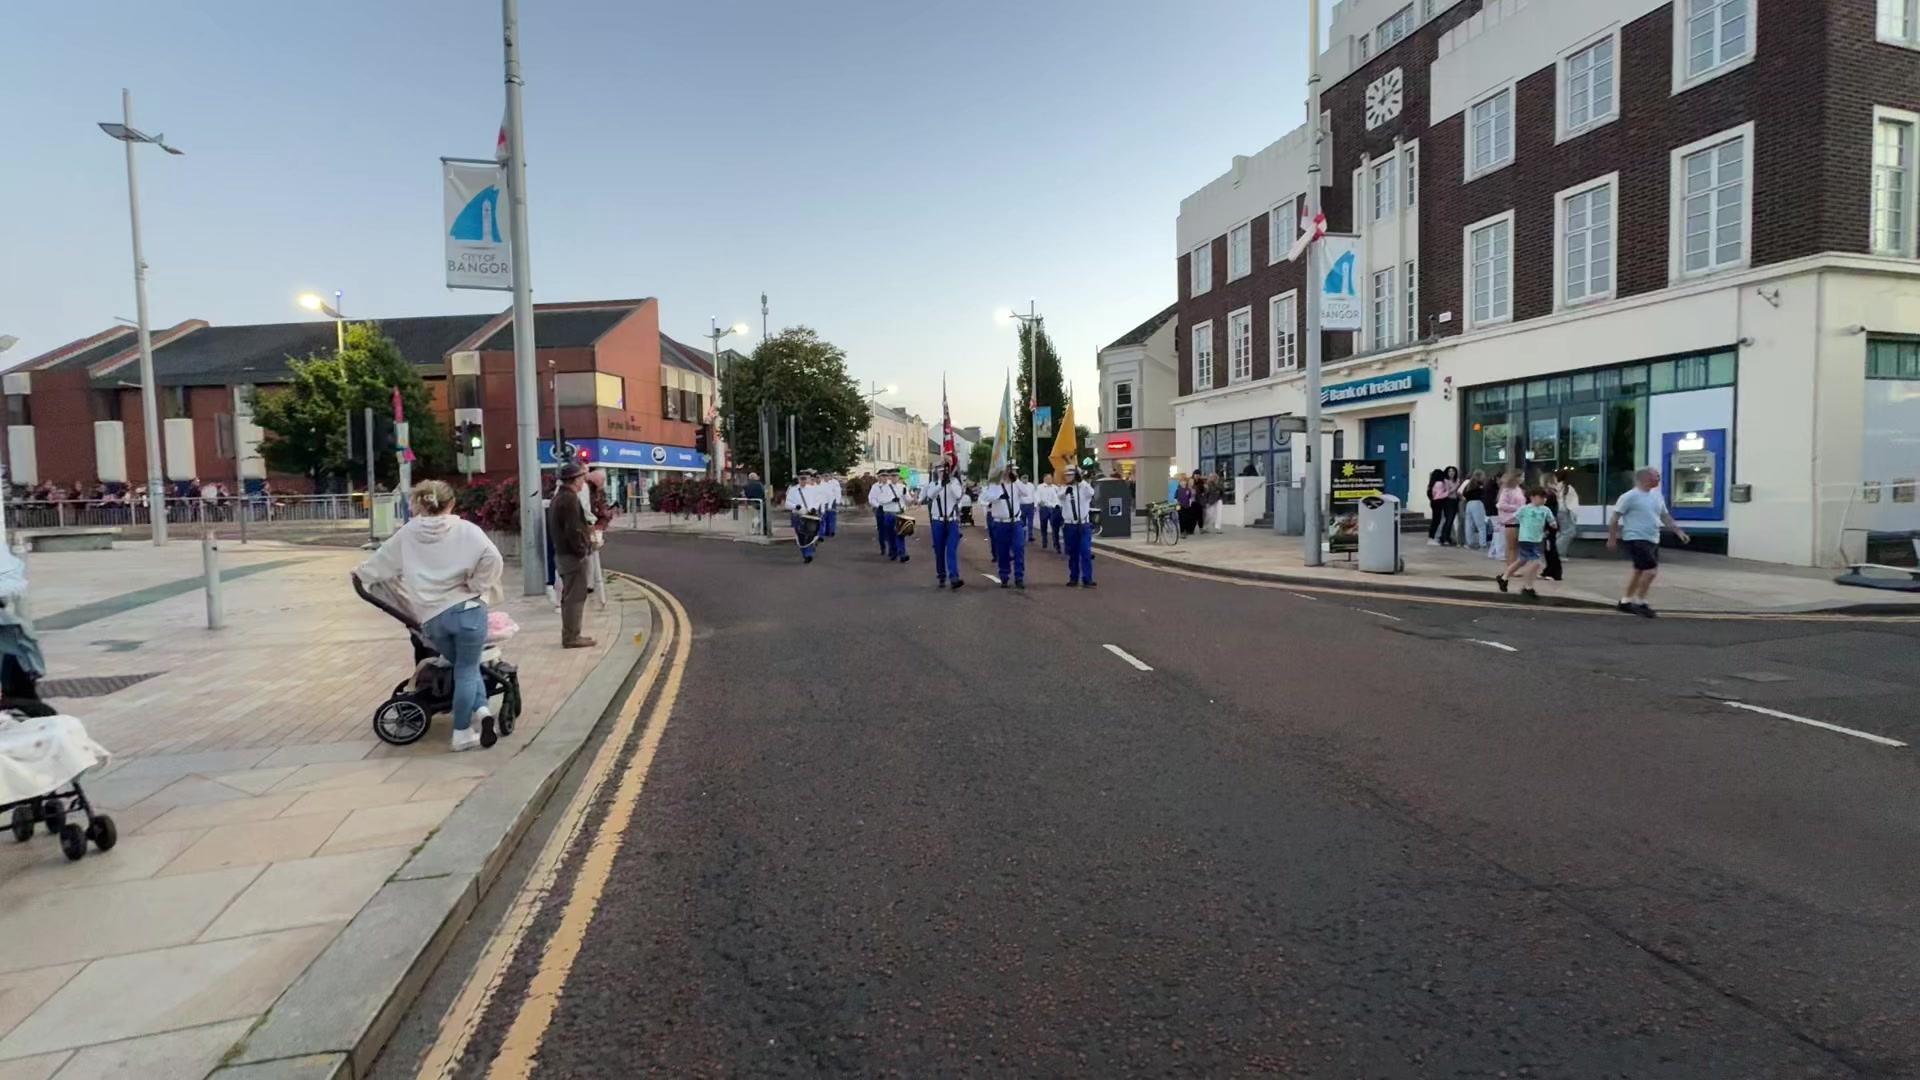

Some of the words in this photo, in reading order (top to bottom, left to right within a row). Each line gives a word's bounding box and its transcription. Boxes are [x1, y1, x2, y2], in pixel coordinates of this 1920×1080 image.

[461, 252, 482, 262] CITY
[483, 253, 496, 262] OF
[448, 260, 508, 274] BANGOR
[1329, 387, 1355, 401] Bank
[1356, 383, 1369, 396] of
[1369, 376, 1412, 395] Ireland
